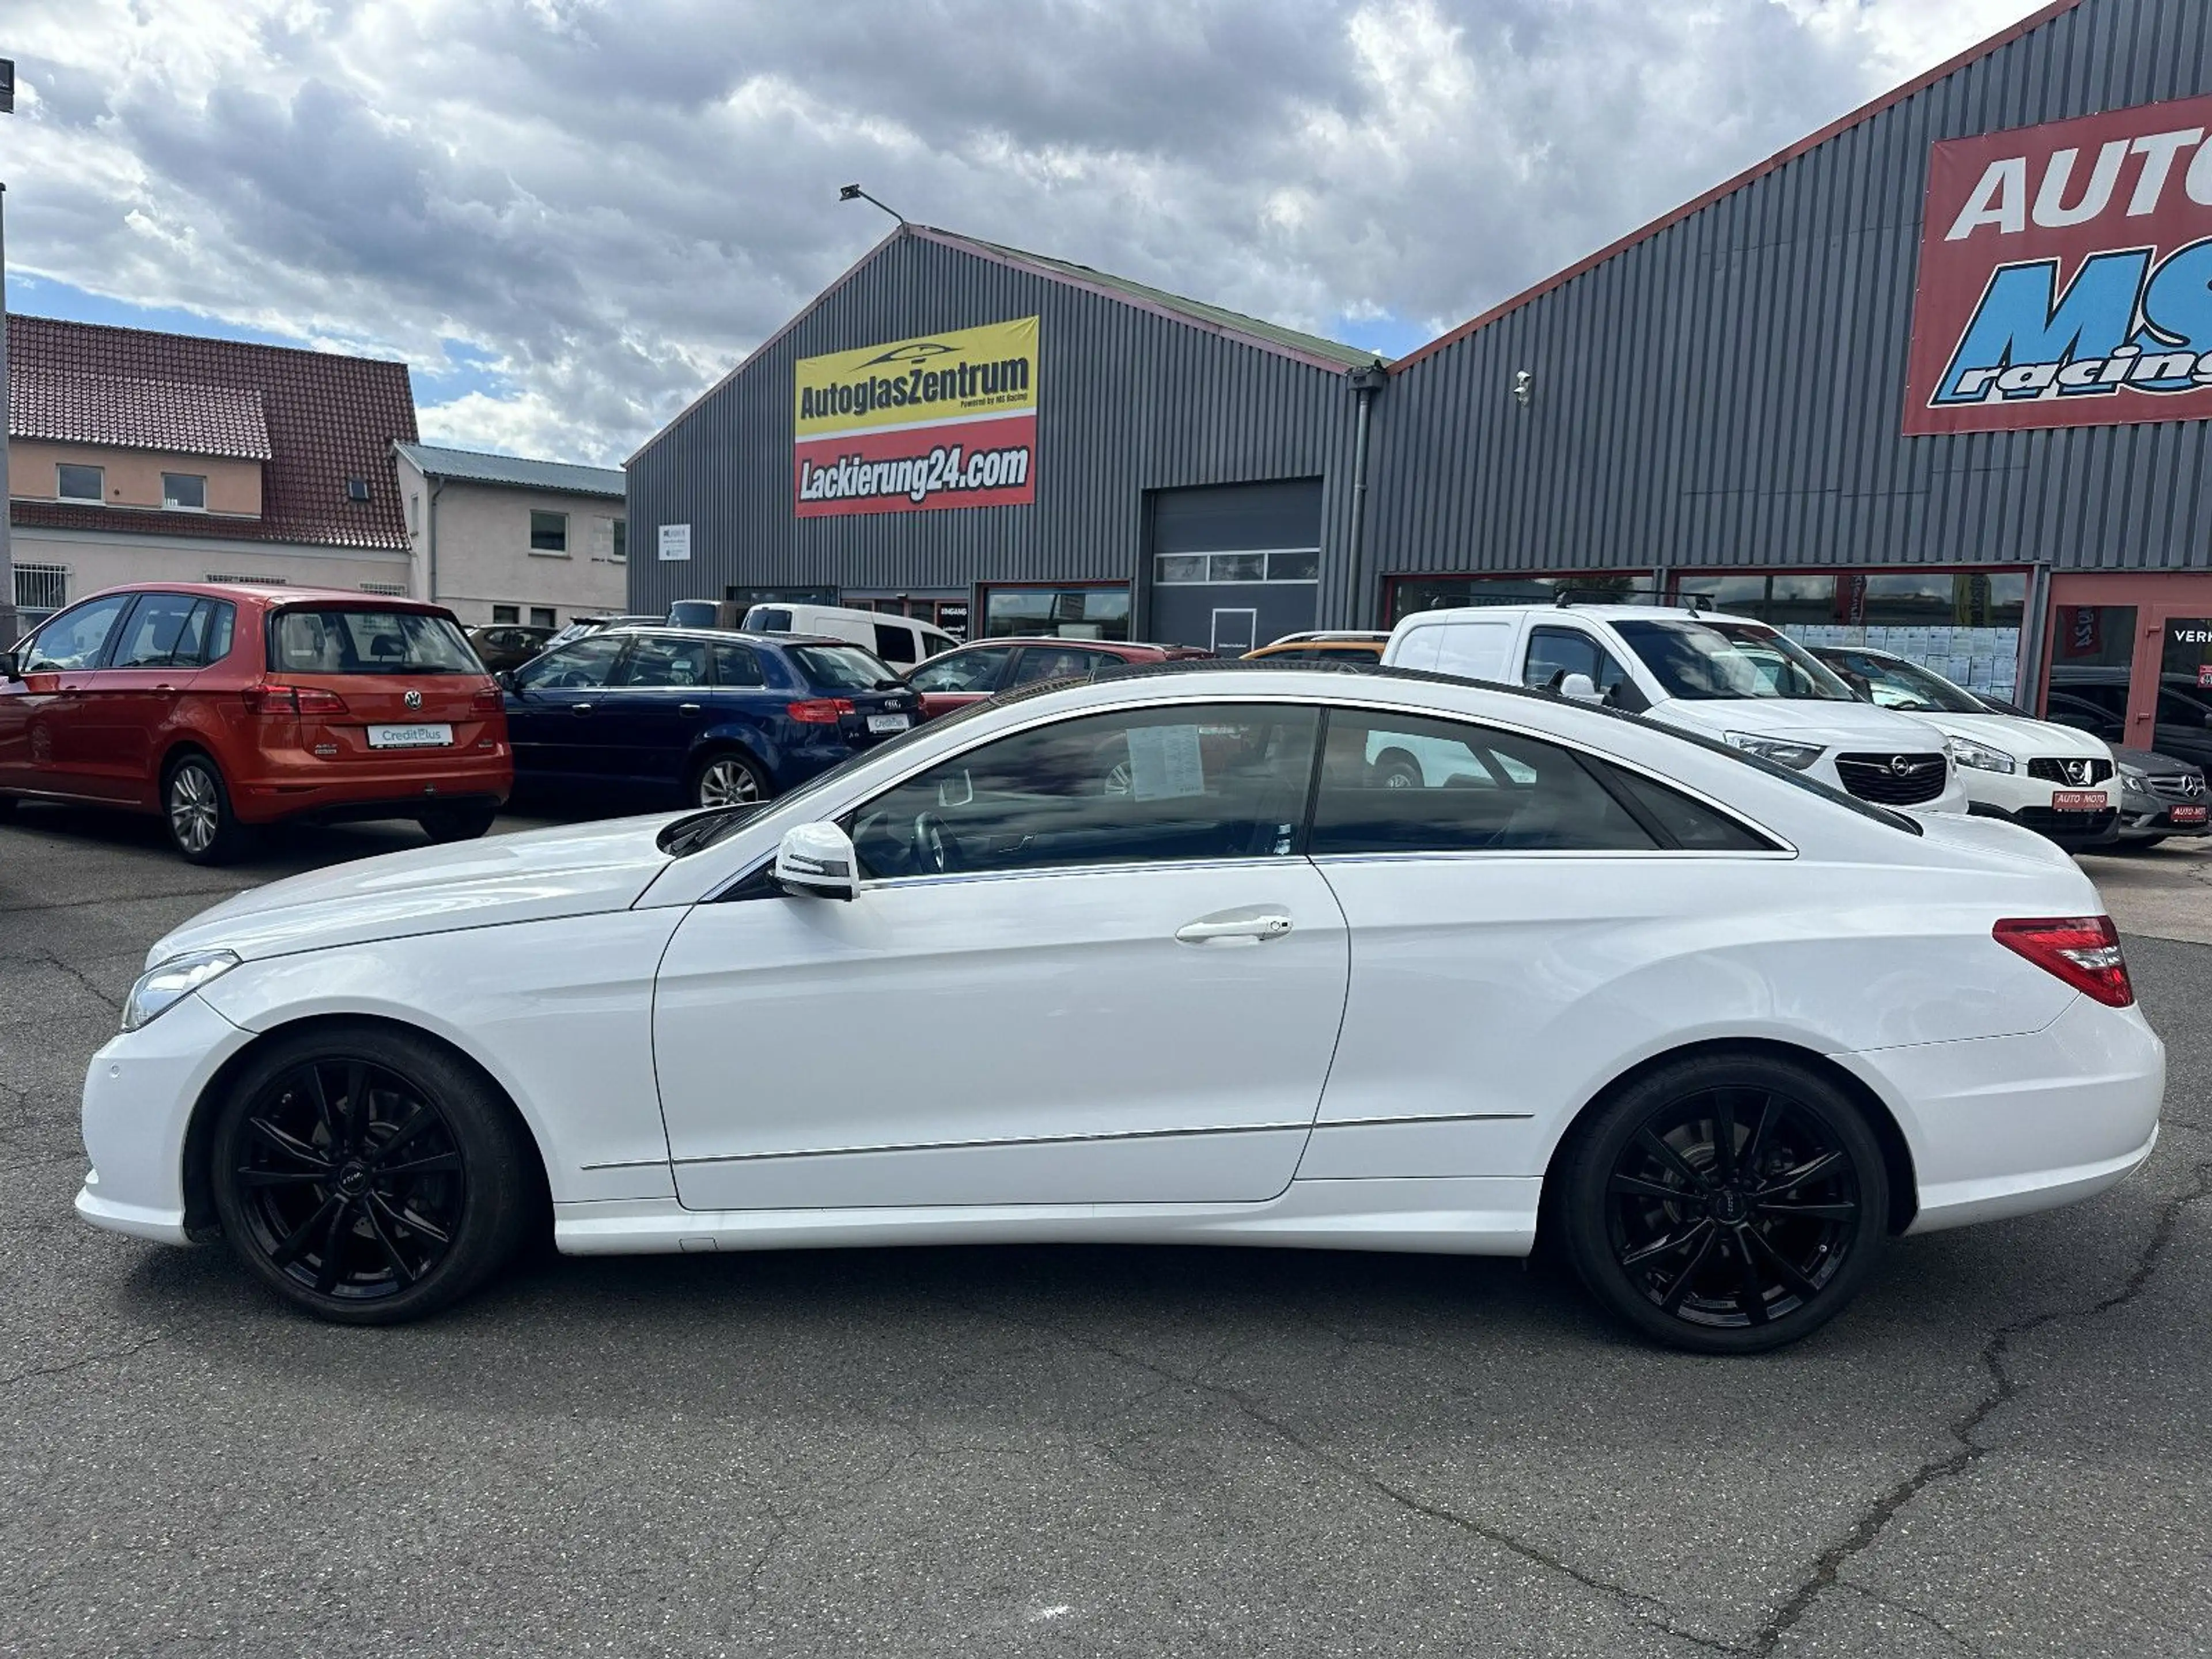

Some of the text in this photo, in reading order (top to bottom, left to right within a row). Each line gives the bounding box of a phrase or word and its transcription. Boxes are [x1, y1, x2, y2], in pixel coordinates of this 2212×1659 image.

[1944, 127, 2212, 241] AUT
[800, 357, 1029, 419] AutoglasZentrum
[798, 445, 1030, 503] Lackierung24.com
